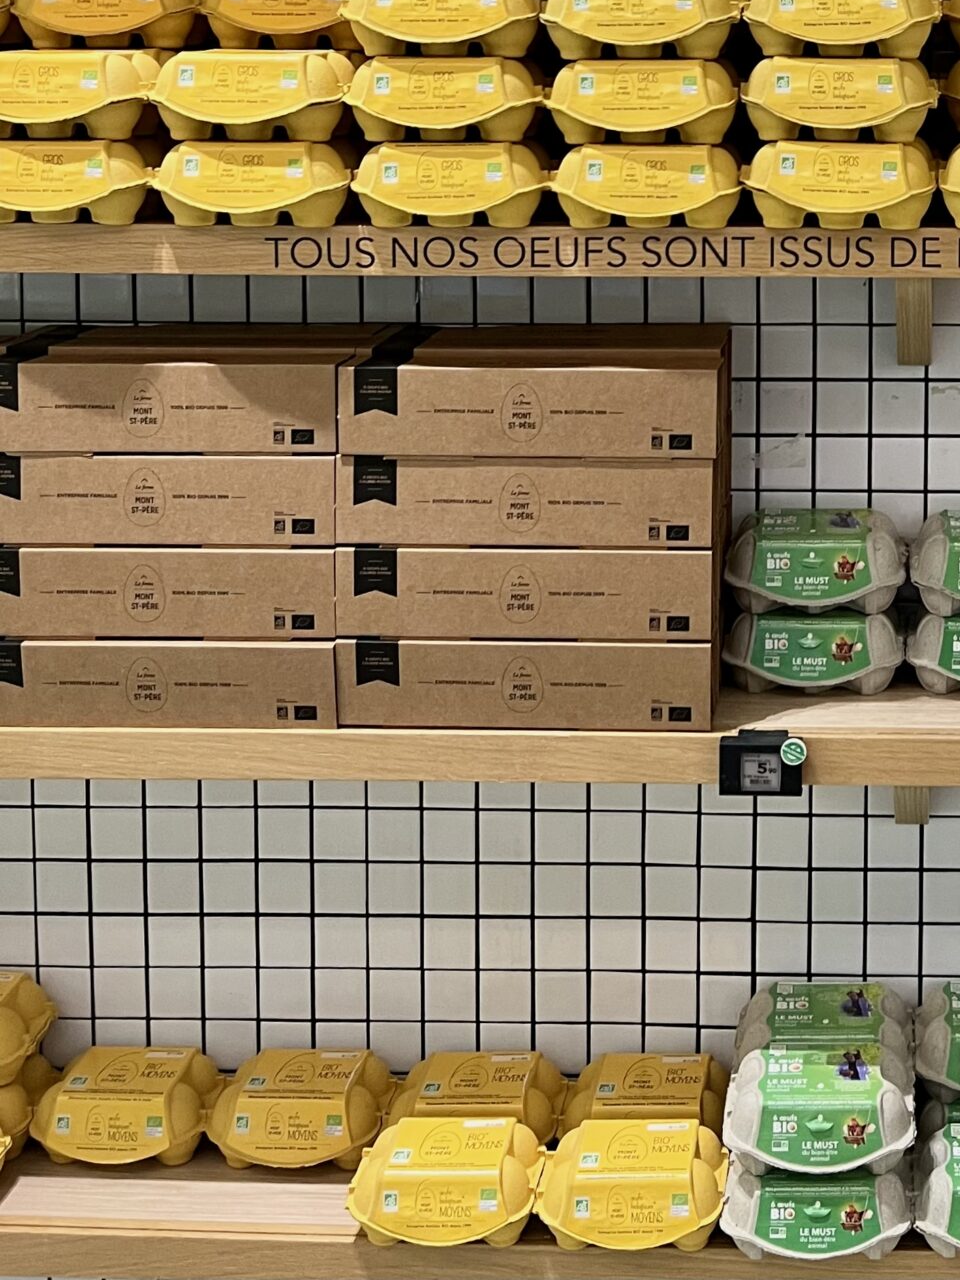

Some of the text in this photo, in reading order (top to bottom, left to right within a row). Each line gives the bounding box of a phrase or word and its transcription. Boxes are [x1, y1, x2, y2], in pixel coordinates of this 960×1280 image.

[264, 237, 375, 268] TOUS
[392, 236, 478, 268] NOS
[494, 236, 626, 268] OEUFS
[642, 236, 755, 267] SONT
[770, 236, 874, 268] ISSUS
[891, 237, 941, 268] DE
[512, 412, 531, 420] MONT
[767, 559, 790, 569] BIO
[806, 576, 829, 584] MUST
[757, 762, 768, 774] 5
[772, 1122, 797, 1133] BIO
[802, 1141, 838, 1149] LE MUST
[770, 1208, 795, 1220] BIO
[800, 1228, 836, 1236] LE MUST
